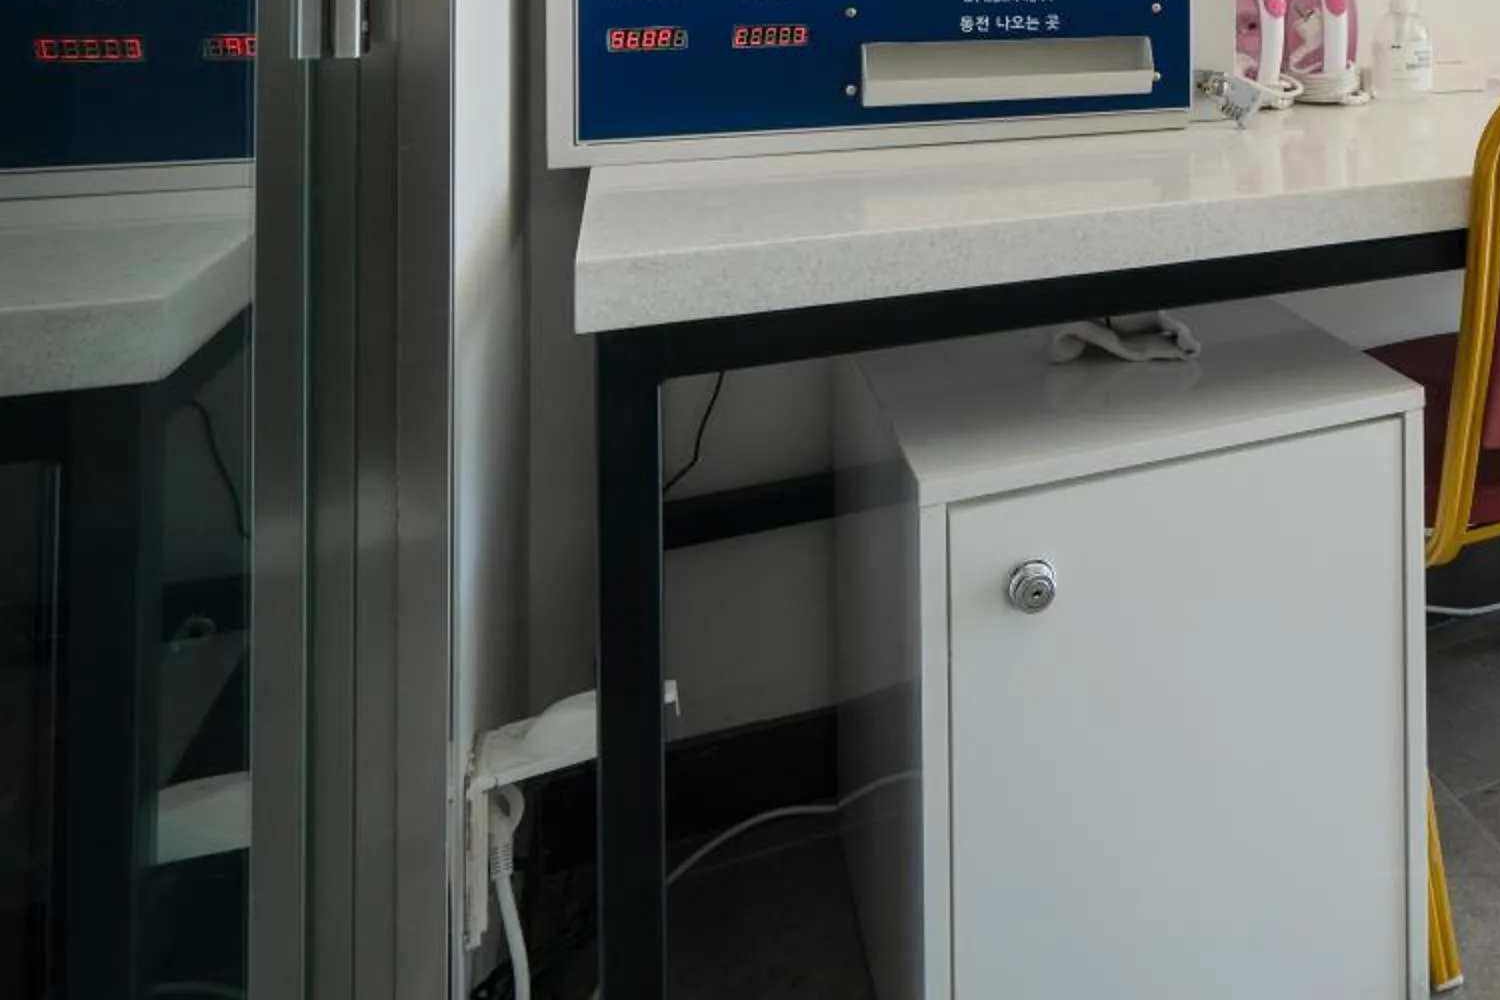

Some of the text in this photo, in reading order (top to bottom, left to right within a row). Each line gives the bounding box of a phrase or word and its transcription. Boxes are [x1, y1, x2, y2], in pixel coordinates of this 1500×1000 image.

[960, 14, 1060, 32] 동전 나오는 곳
